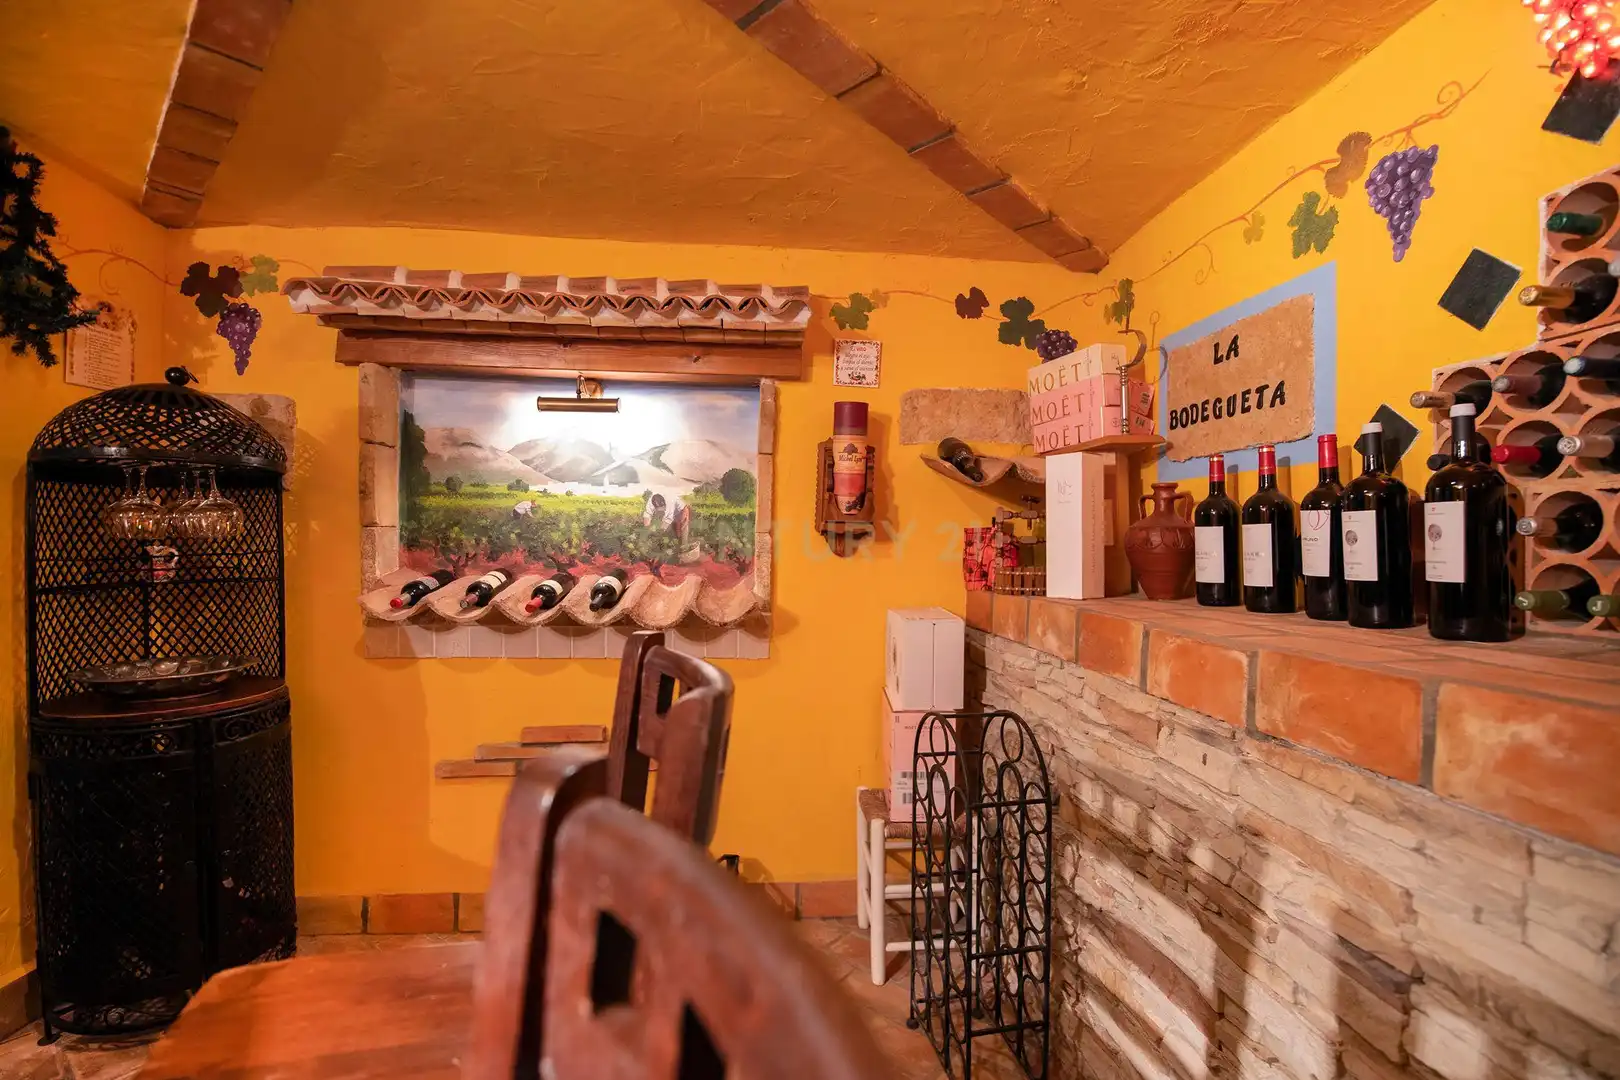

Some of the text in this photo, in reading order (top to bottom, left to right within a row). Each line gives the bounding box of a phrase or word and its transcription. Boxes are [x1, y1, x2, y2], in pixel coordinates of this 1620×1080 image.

[1212, 333, 1240, 366] LA
[1028, 362, 1081, 397] MOËT
[1032, 392, 1085, 424] MOËT
[1168, 380, 1286, 431] BODEGUETA
[1035, 424, 1083, 451] MOËT
